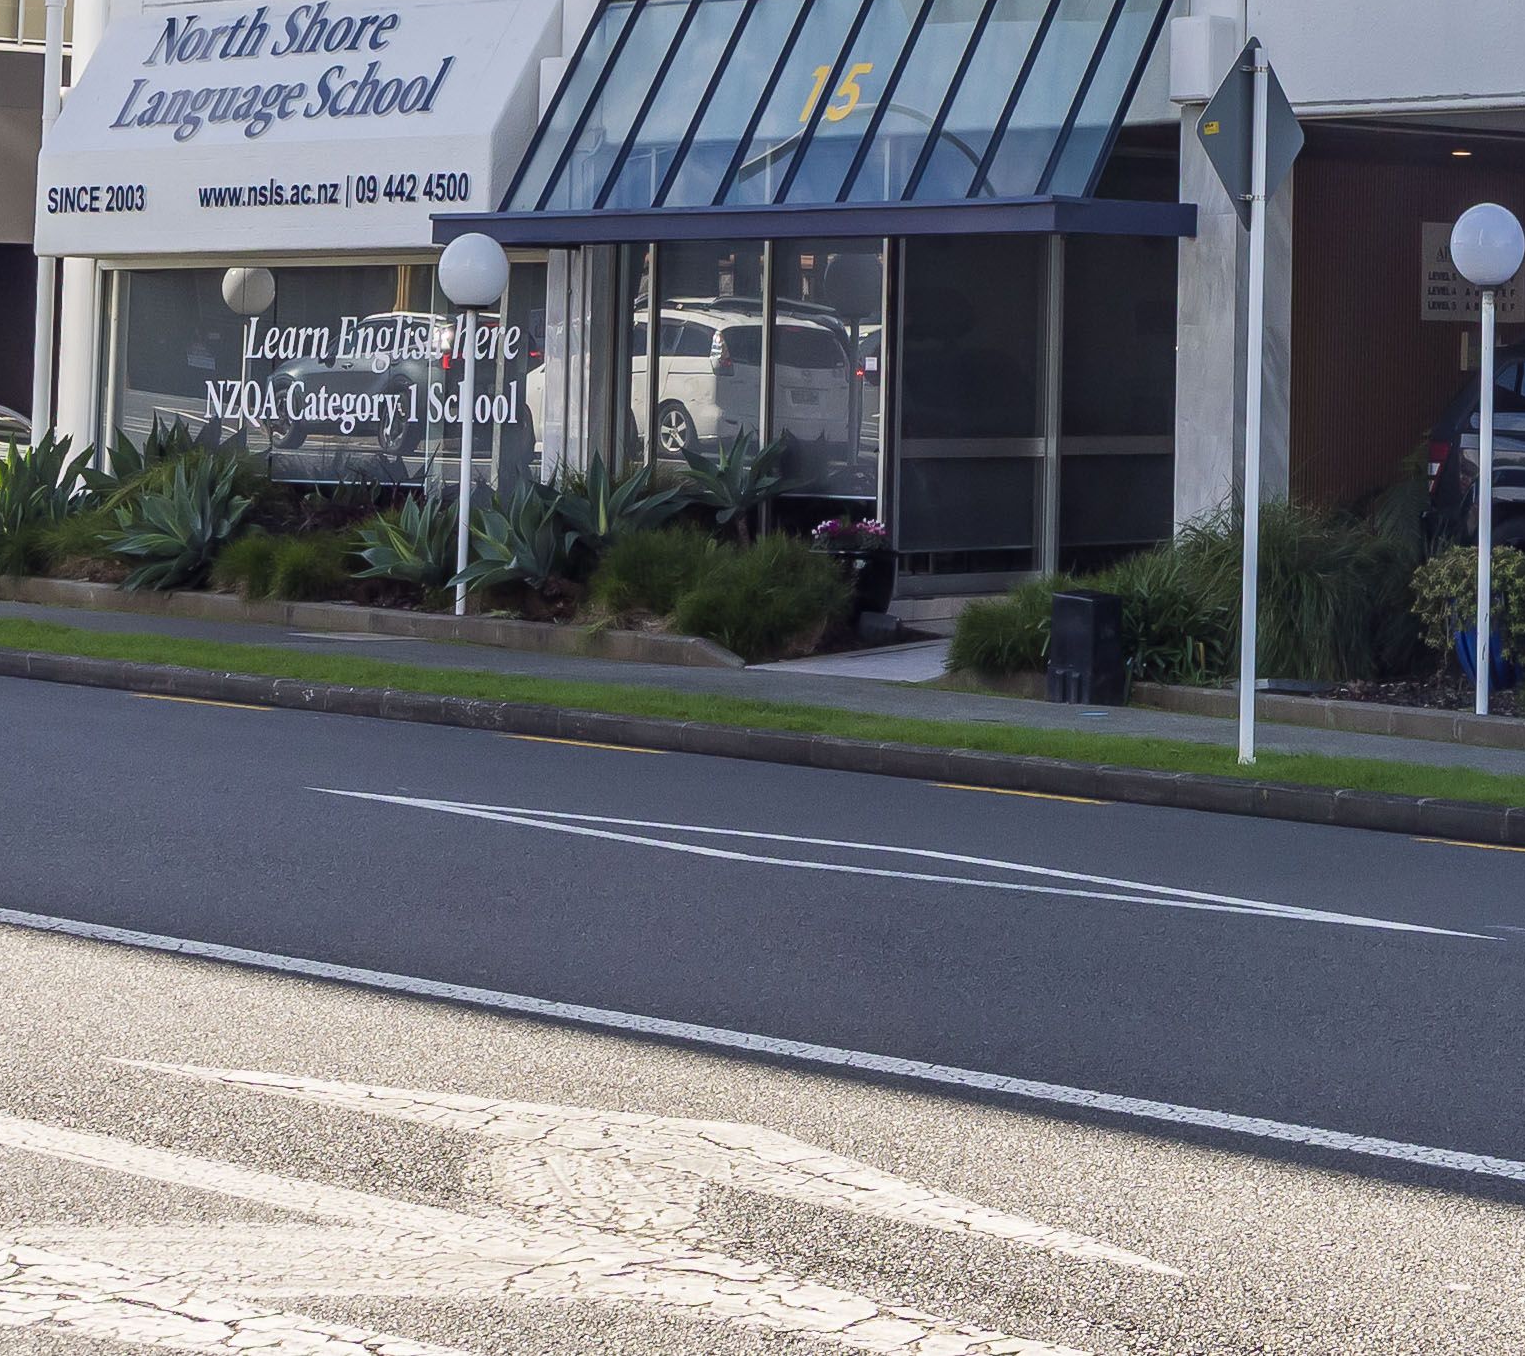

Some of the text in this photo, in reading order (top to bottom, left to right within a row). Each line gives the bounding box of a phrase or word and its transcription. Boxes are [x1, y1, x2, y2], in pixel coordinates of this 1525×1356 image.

[145, 1, 400, 67] North Shore
[110, 56, 455, 142] Language School
[800, 63, 873, 122] 15
[47, 183, 146, 214] SINCE 2003
[199, 172, 470, 208] www.nsls.ac.nz 09 442 4500
[242, 314, 522, 375] Learn English here
[204, 378, 283, 429] NZQA
[286, 379, 402, 437] Category
[406, 383, 419, 425] 1
